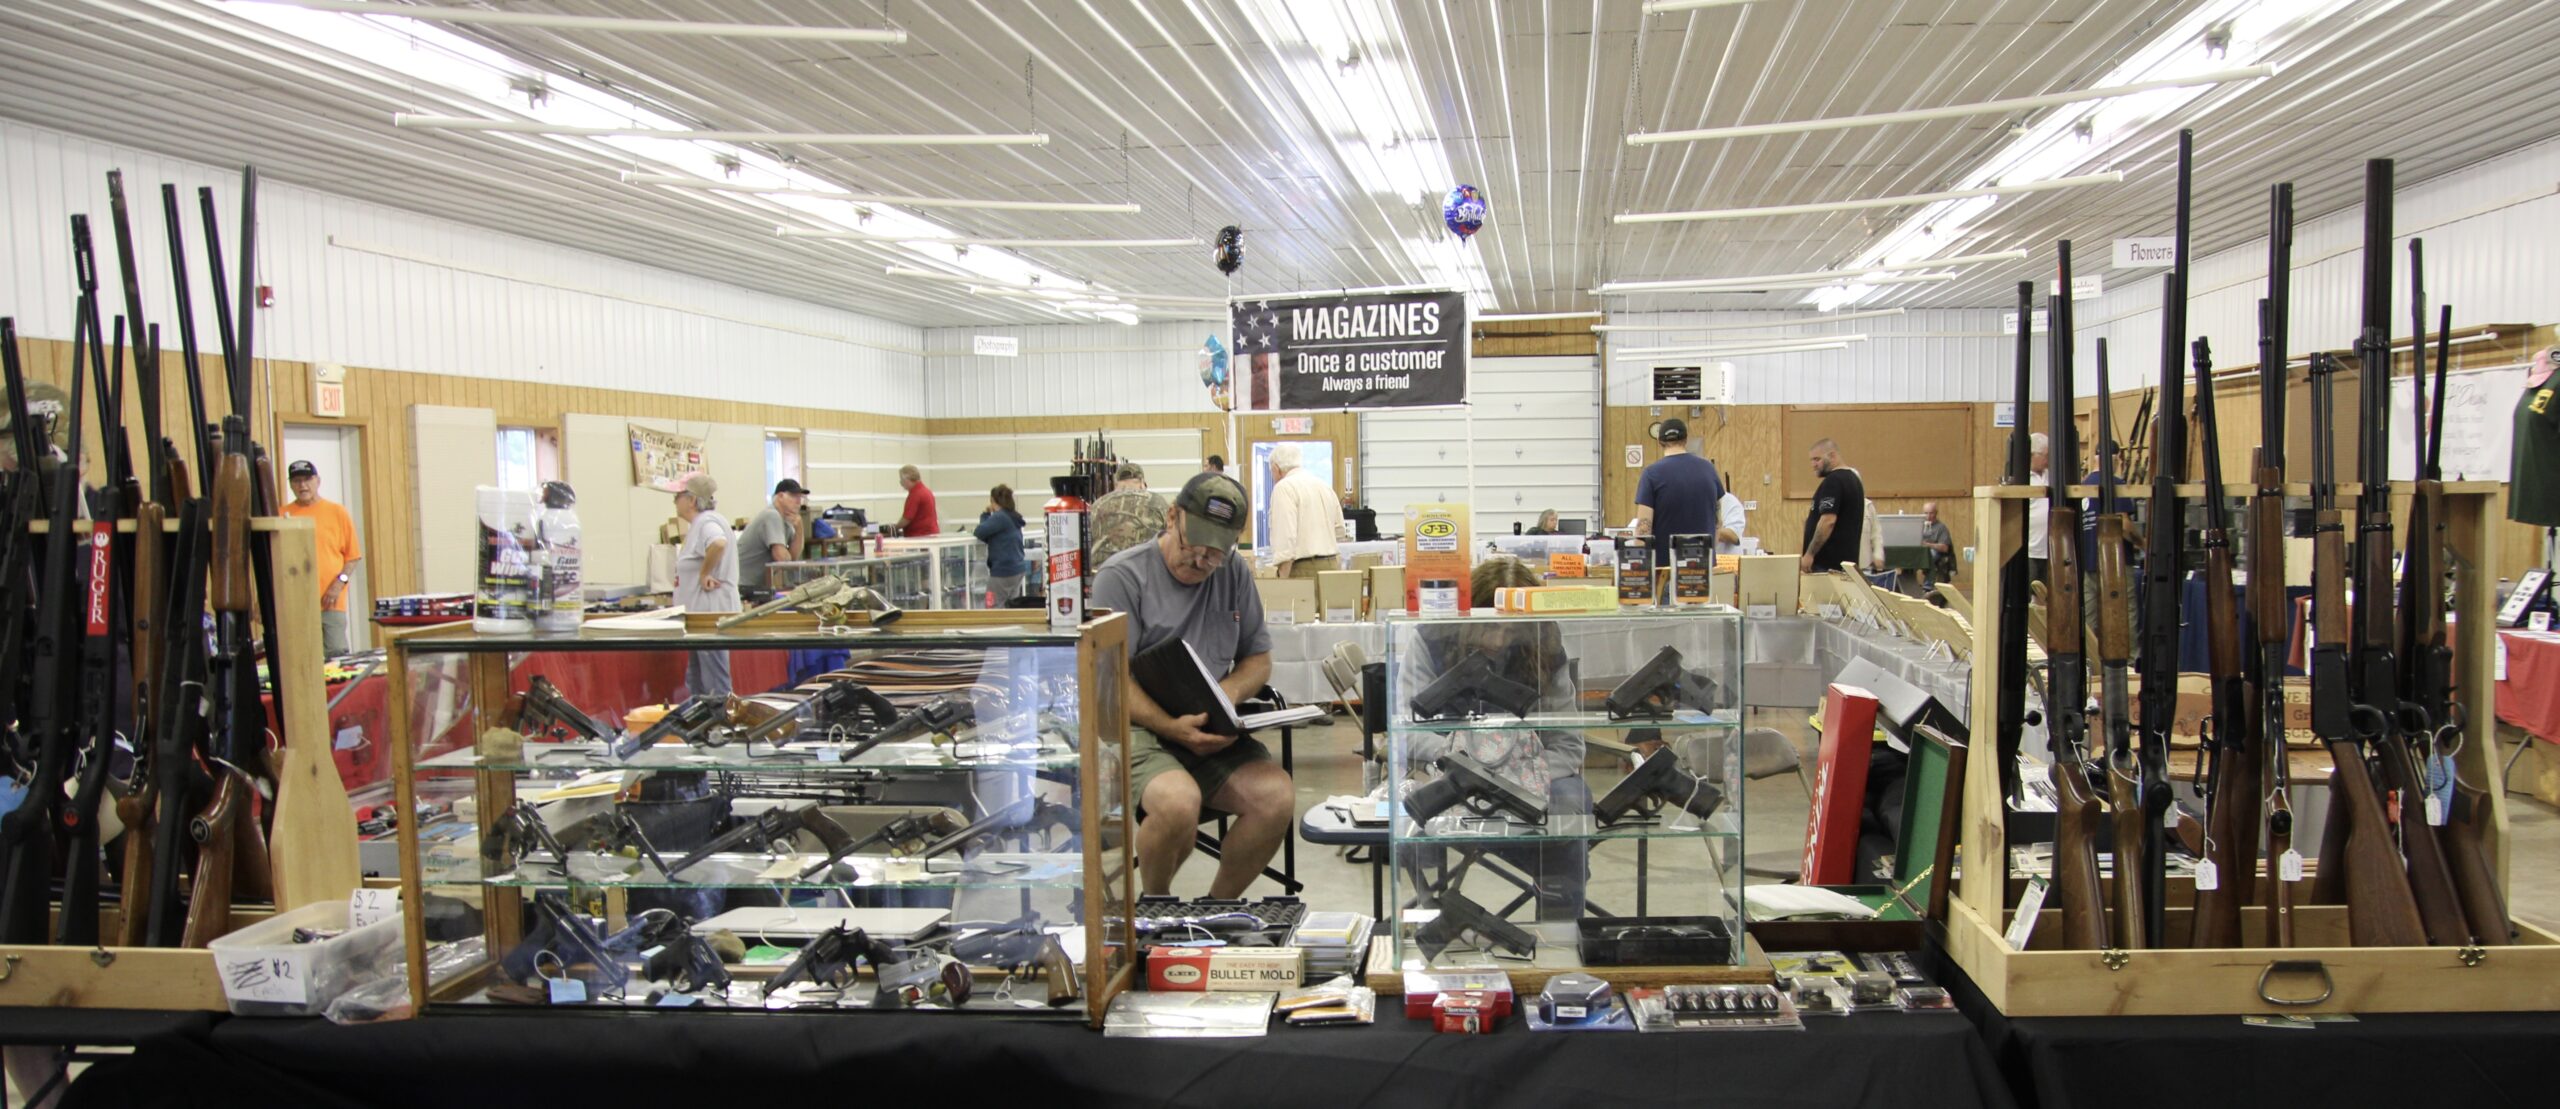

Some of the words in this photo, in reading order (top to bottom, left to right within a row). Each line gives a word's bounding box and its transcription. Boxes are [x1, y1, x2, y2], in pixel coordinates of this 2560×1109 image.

[2130, 243, 2174, 261] Flowers
[1292, 302, 1440, 341] MAGAZINES
[1297, 352, 1340, 375] Once
[1345, 355, 1356, 372] a
[1360, 349, 1446, 372] customer
[1322, 375, 1363, 393] Always
[1365, 378, 1373, 390] a
[1375, 374, 1410, 390] friend
[323, 386, 341, 411] EXIT
[1050, 515, 1068, 525] GUN
[1051, 526, 1064, 536] OIL
[1424, 524, 1449, 534] J-B
[1051, 552, 1078, 565] PROTECT
[1053, 568, 1076, 580] LONGER
[91, 549, 106, 624] RUGER
[1210, 969, 1255, 980] BULLET
[1260, 970, 1295, 981] MOLD
